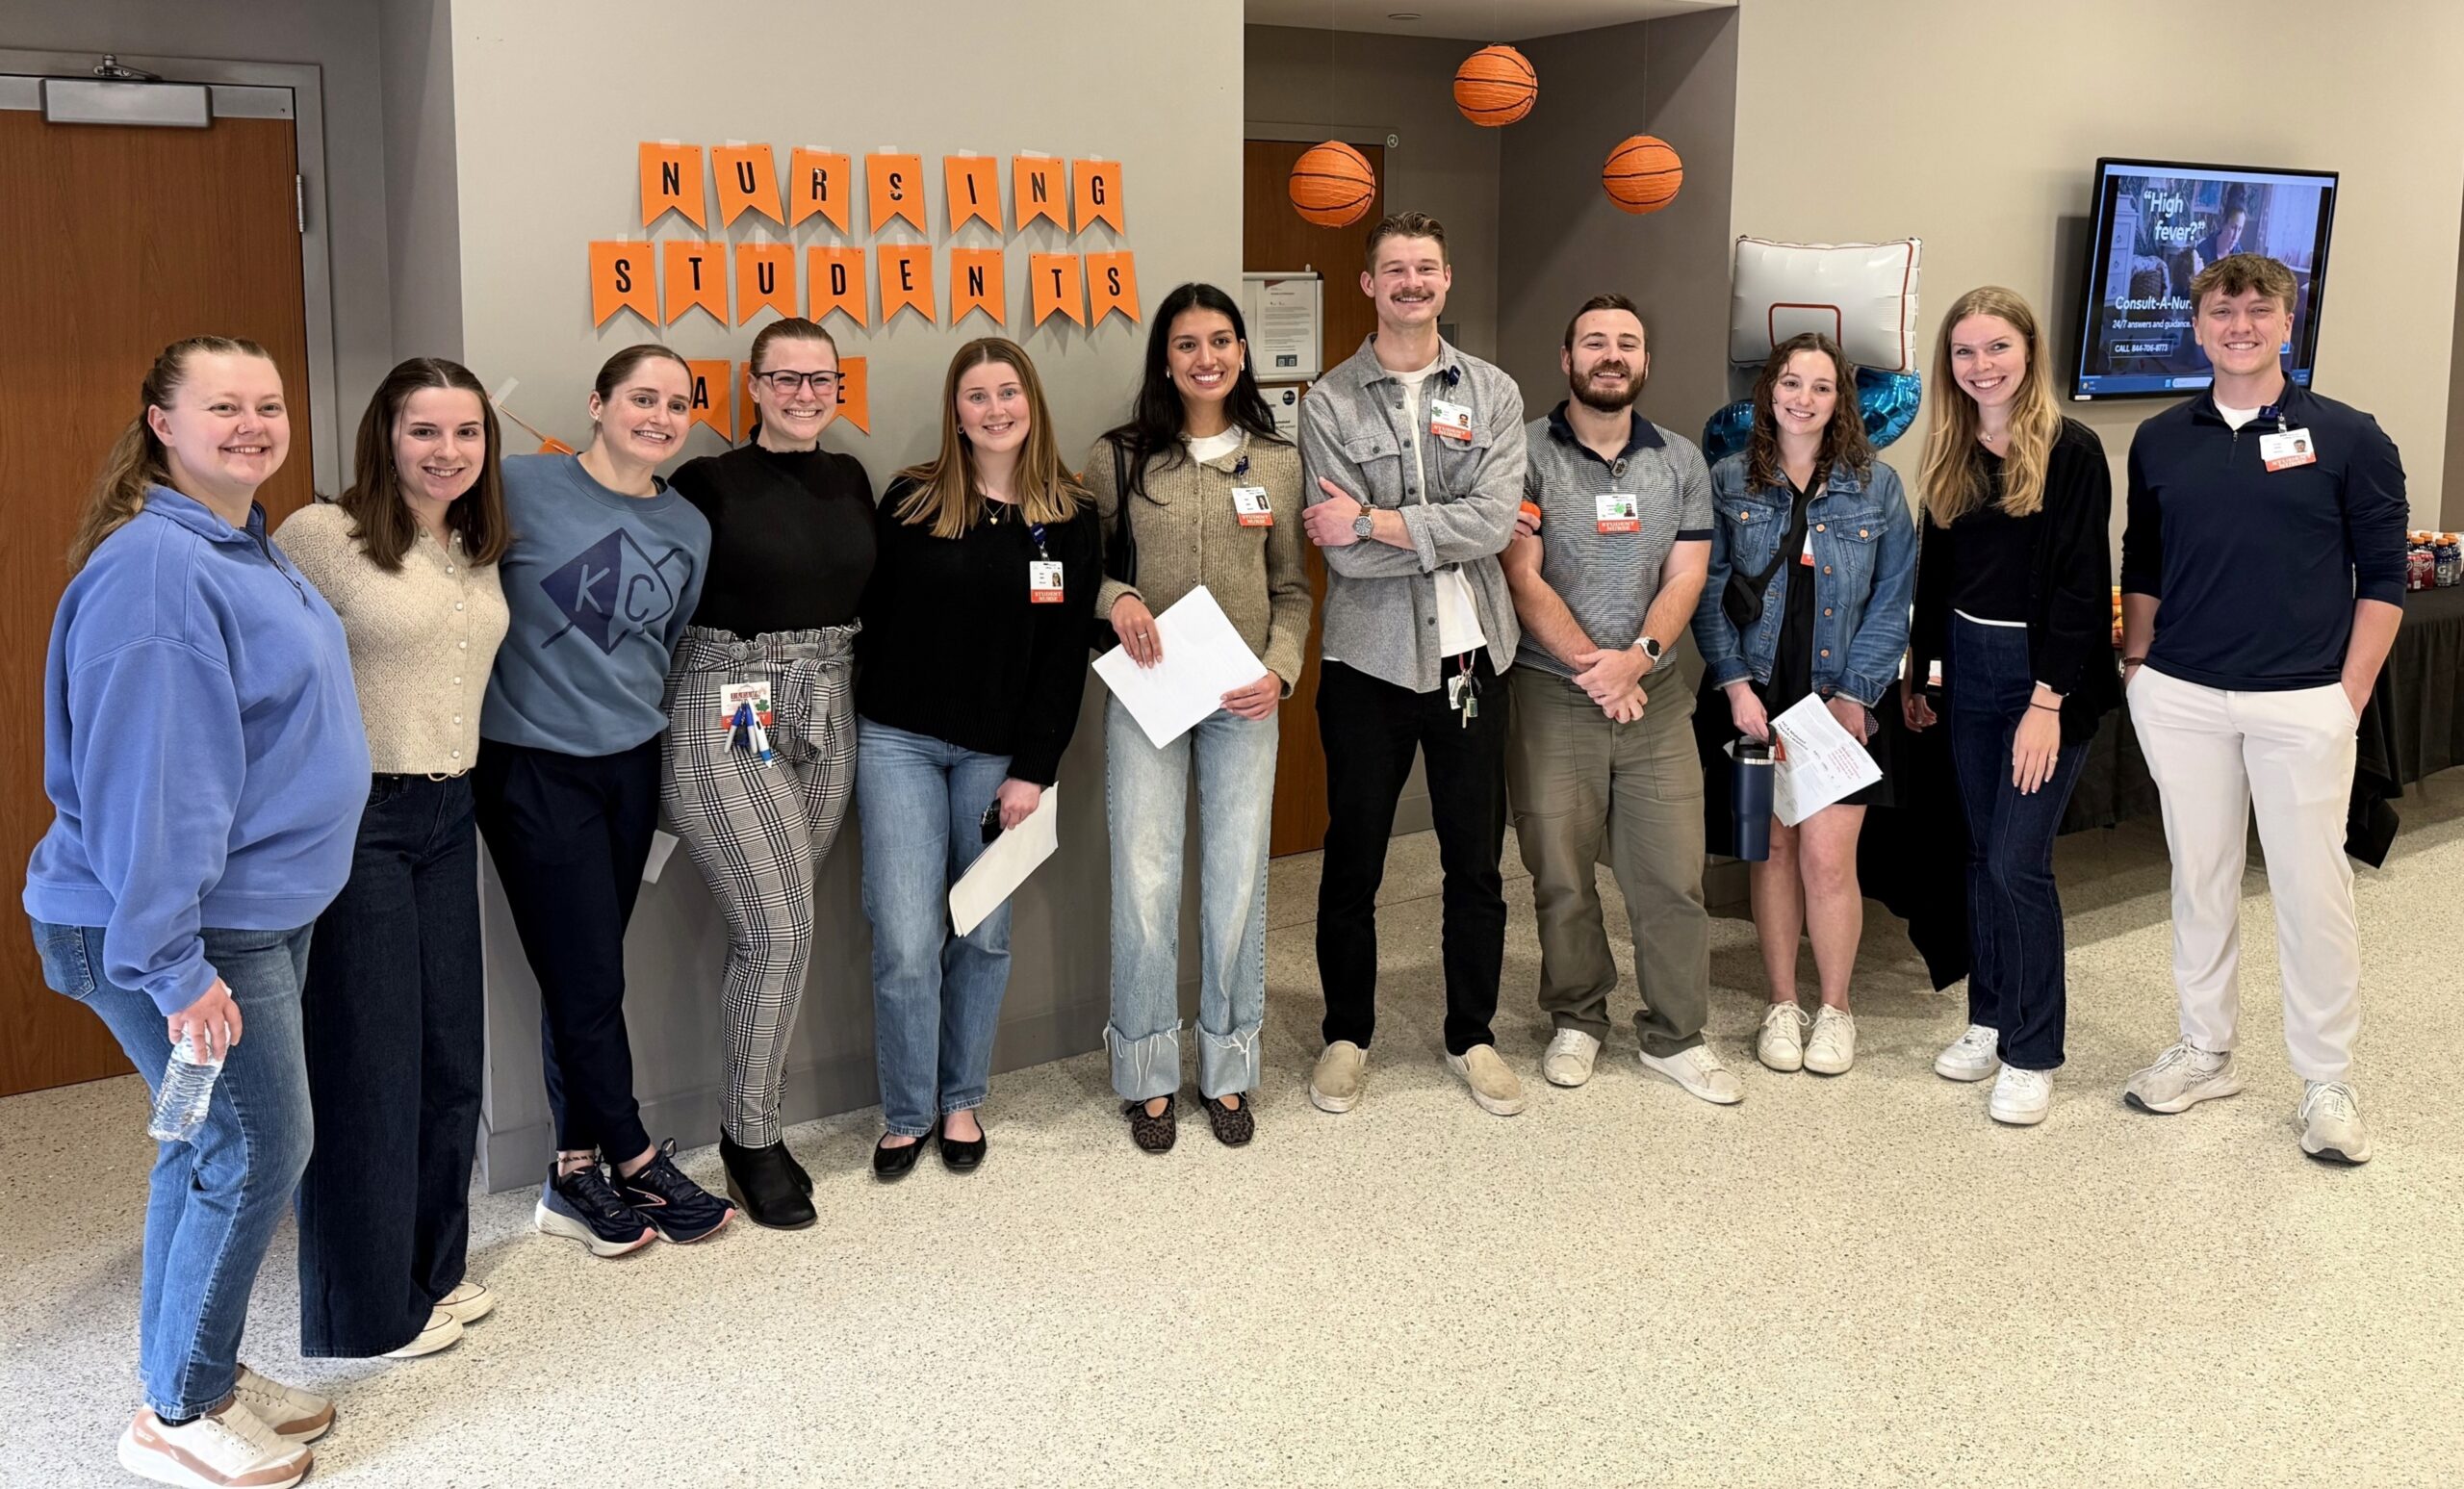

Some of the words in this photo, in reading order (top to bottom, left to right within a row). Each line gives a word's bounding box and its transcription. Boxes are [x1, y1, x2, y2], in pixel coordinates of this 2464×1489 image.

[661, 160, 1106, 206] NURSING
[2143, 191, 2184, 218] “High
[2154, 220, 2206, 242] fever?”
[614, 256, 1121, 298] STUDENTS
[2115, 295, 2193, 310] Consult-A-Nur
[2112, 320, 2128, 329] 24/7
[2152, 319, 2164, 328] and
[2115, 344, 2130, 352] CALL
[692, 372, 847, 410] AE
[1433, 424, 1467, 435] STUDENT
[575, 563, 655, 623] KC
